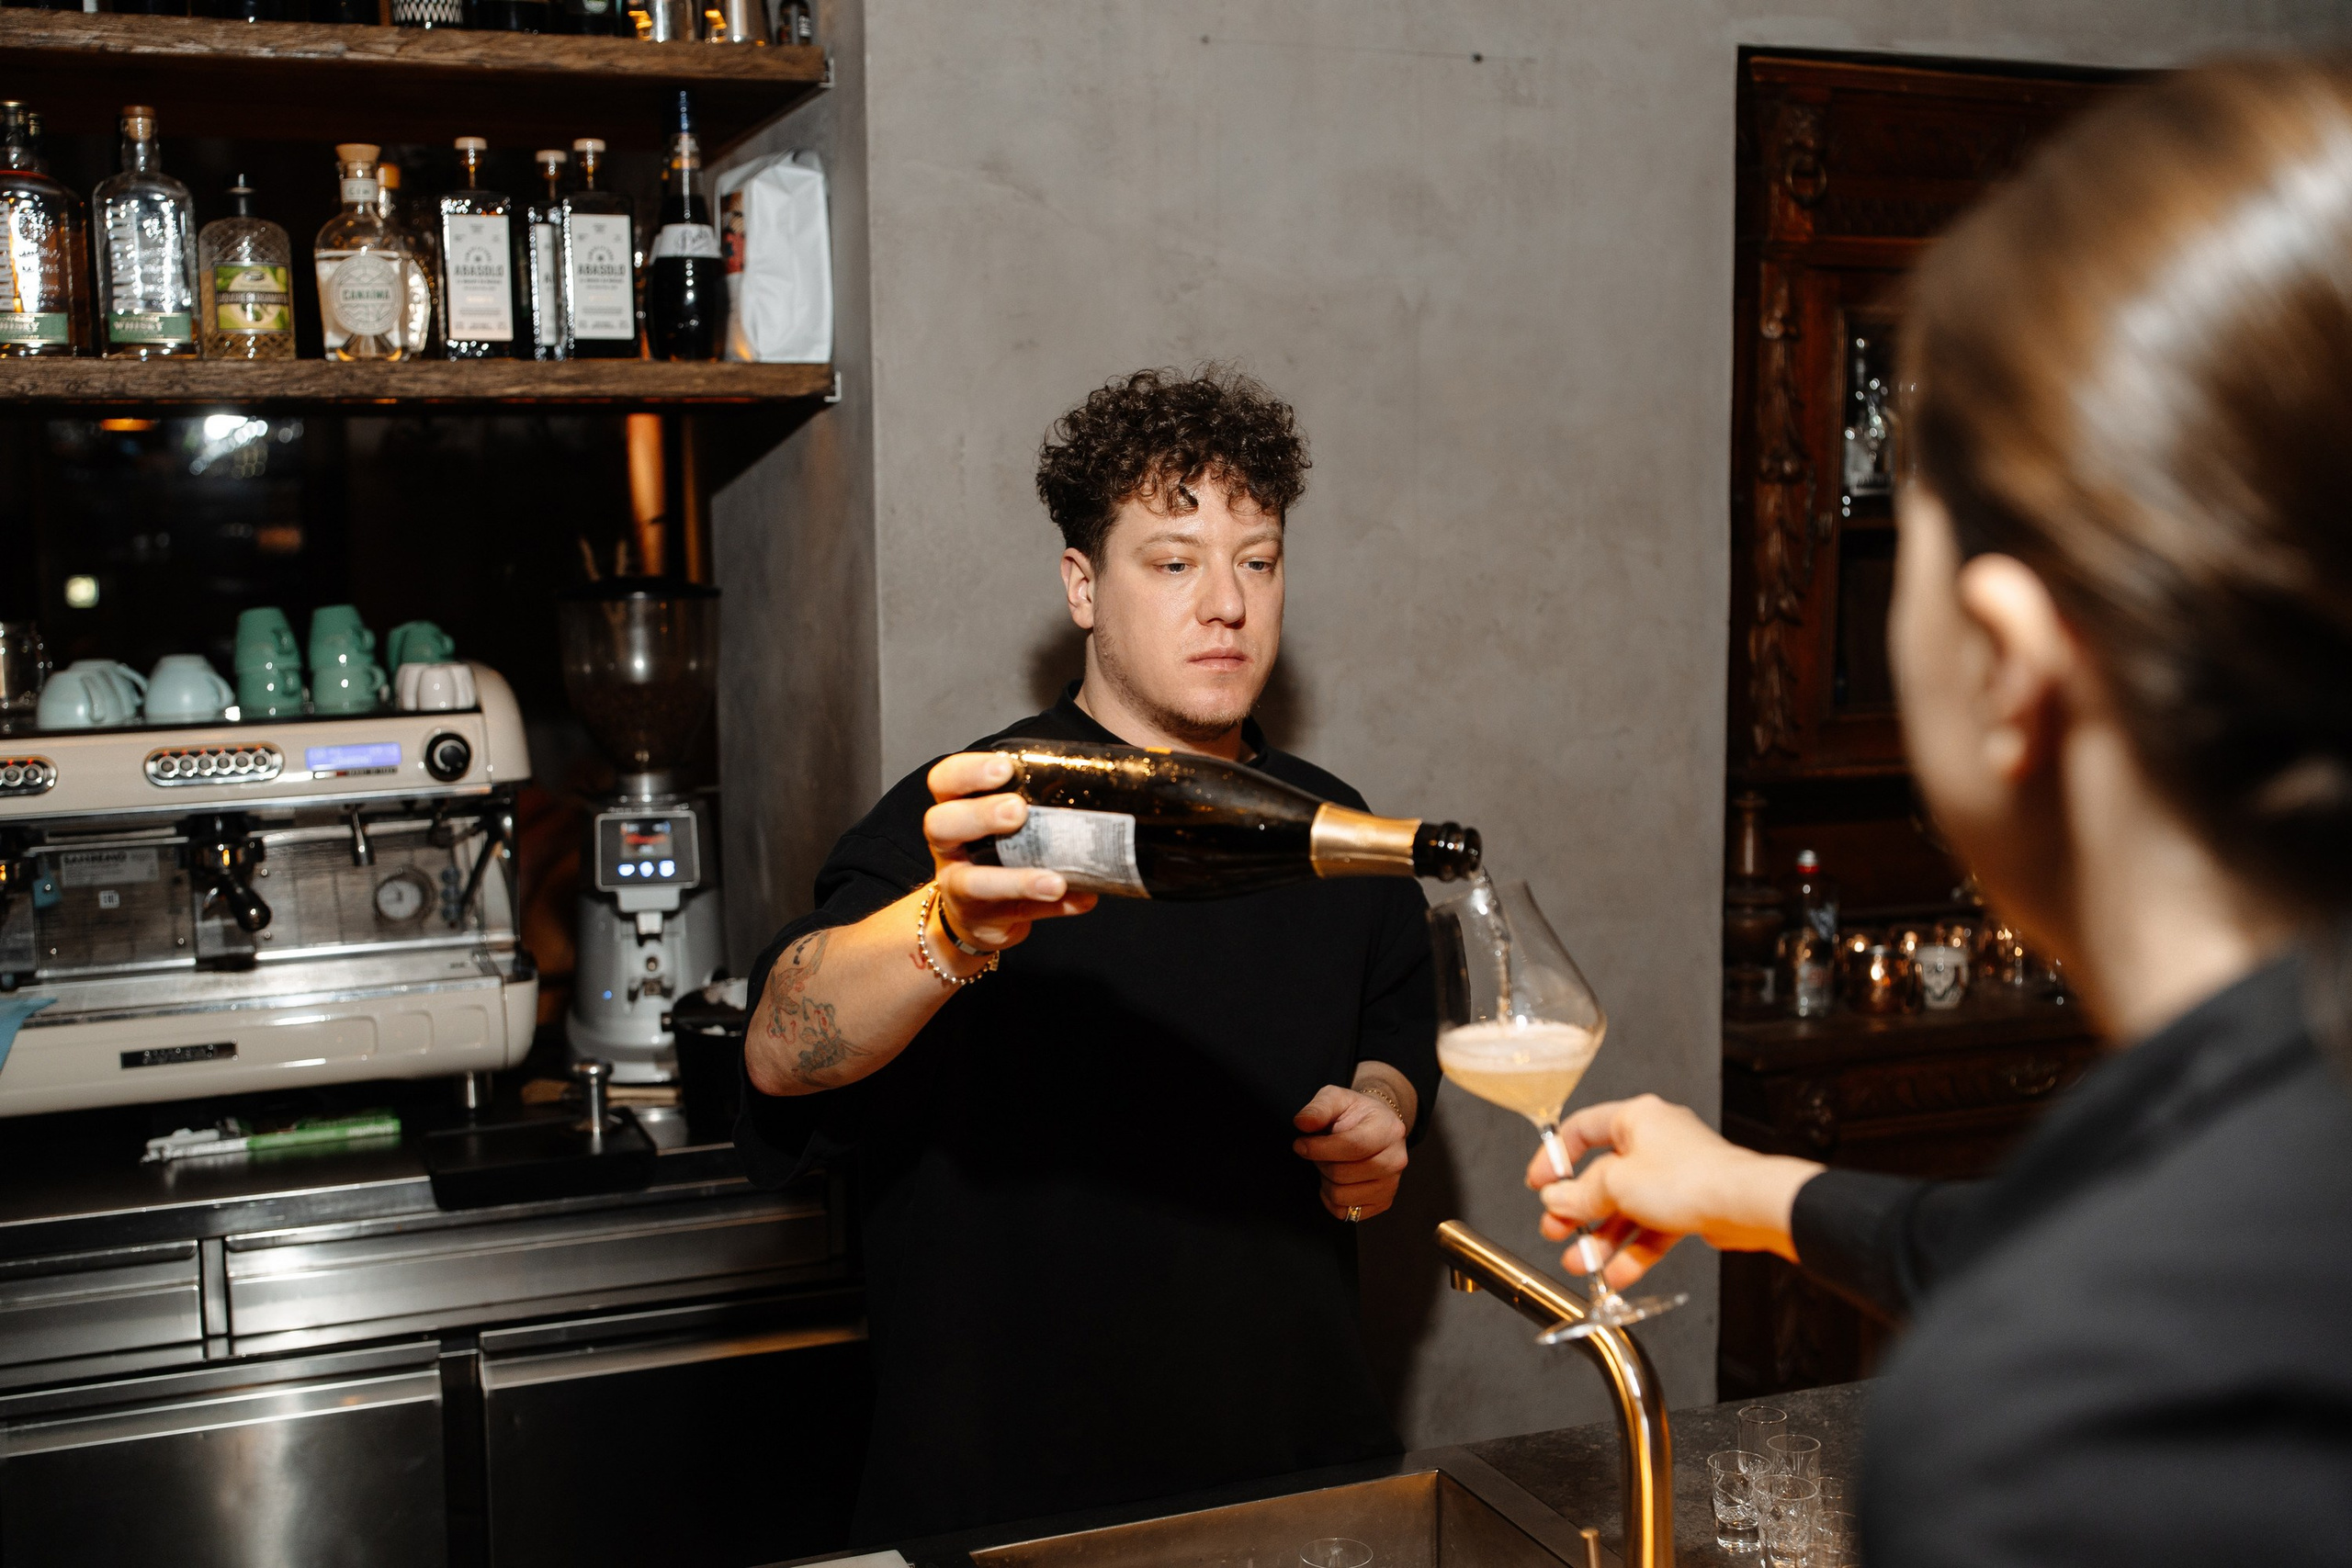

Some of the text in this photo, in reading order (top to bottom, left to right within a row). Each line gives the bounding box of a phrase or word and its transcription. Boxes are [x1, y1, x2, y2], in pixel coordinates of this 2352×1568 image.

[455, 264, 504, 276] ABASOLO
[578, 263, 626, 276] ABASOLO
[342, 289, 390, 300] CANAIMA
[113, 321, 164, 332] WHISKY
